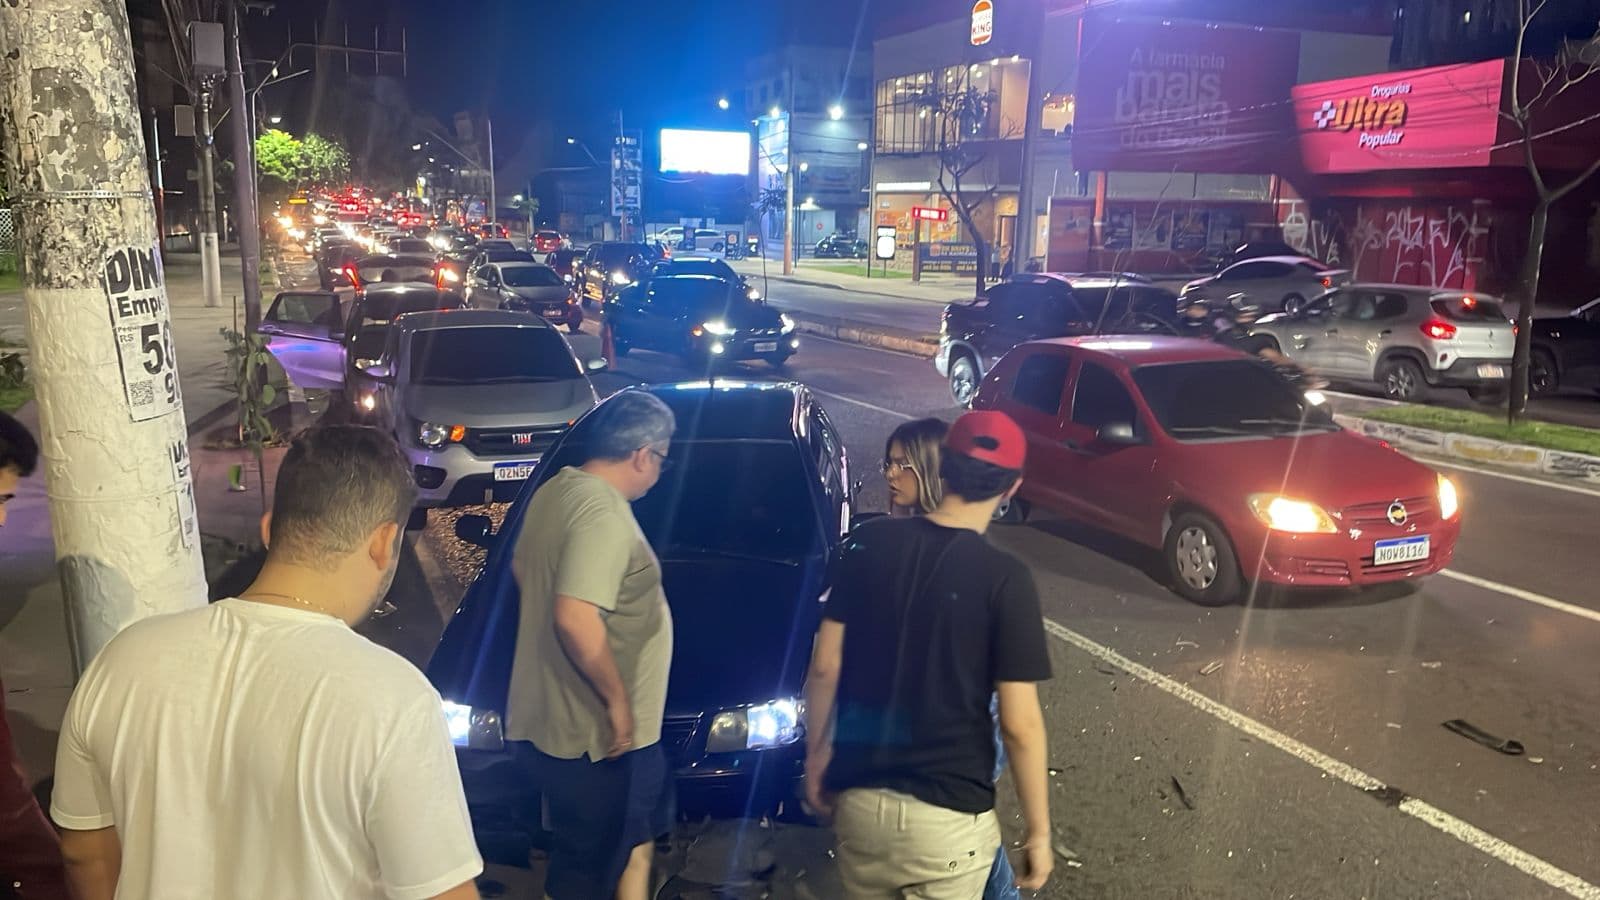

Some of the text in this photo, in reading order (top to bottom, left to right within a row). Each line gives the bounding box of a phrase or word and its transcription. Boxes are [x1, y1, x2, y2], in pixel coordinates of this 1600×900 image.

[1127, 70, 1220, 101] mais
[1371, 82, 1411, 98] Drogarias
[1334, 96, 1406, 131] Ultra
[1358, 129, 1404, 150] Popular
